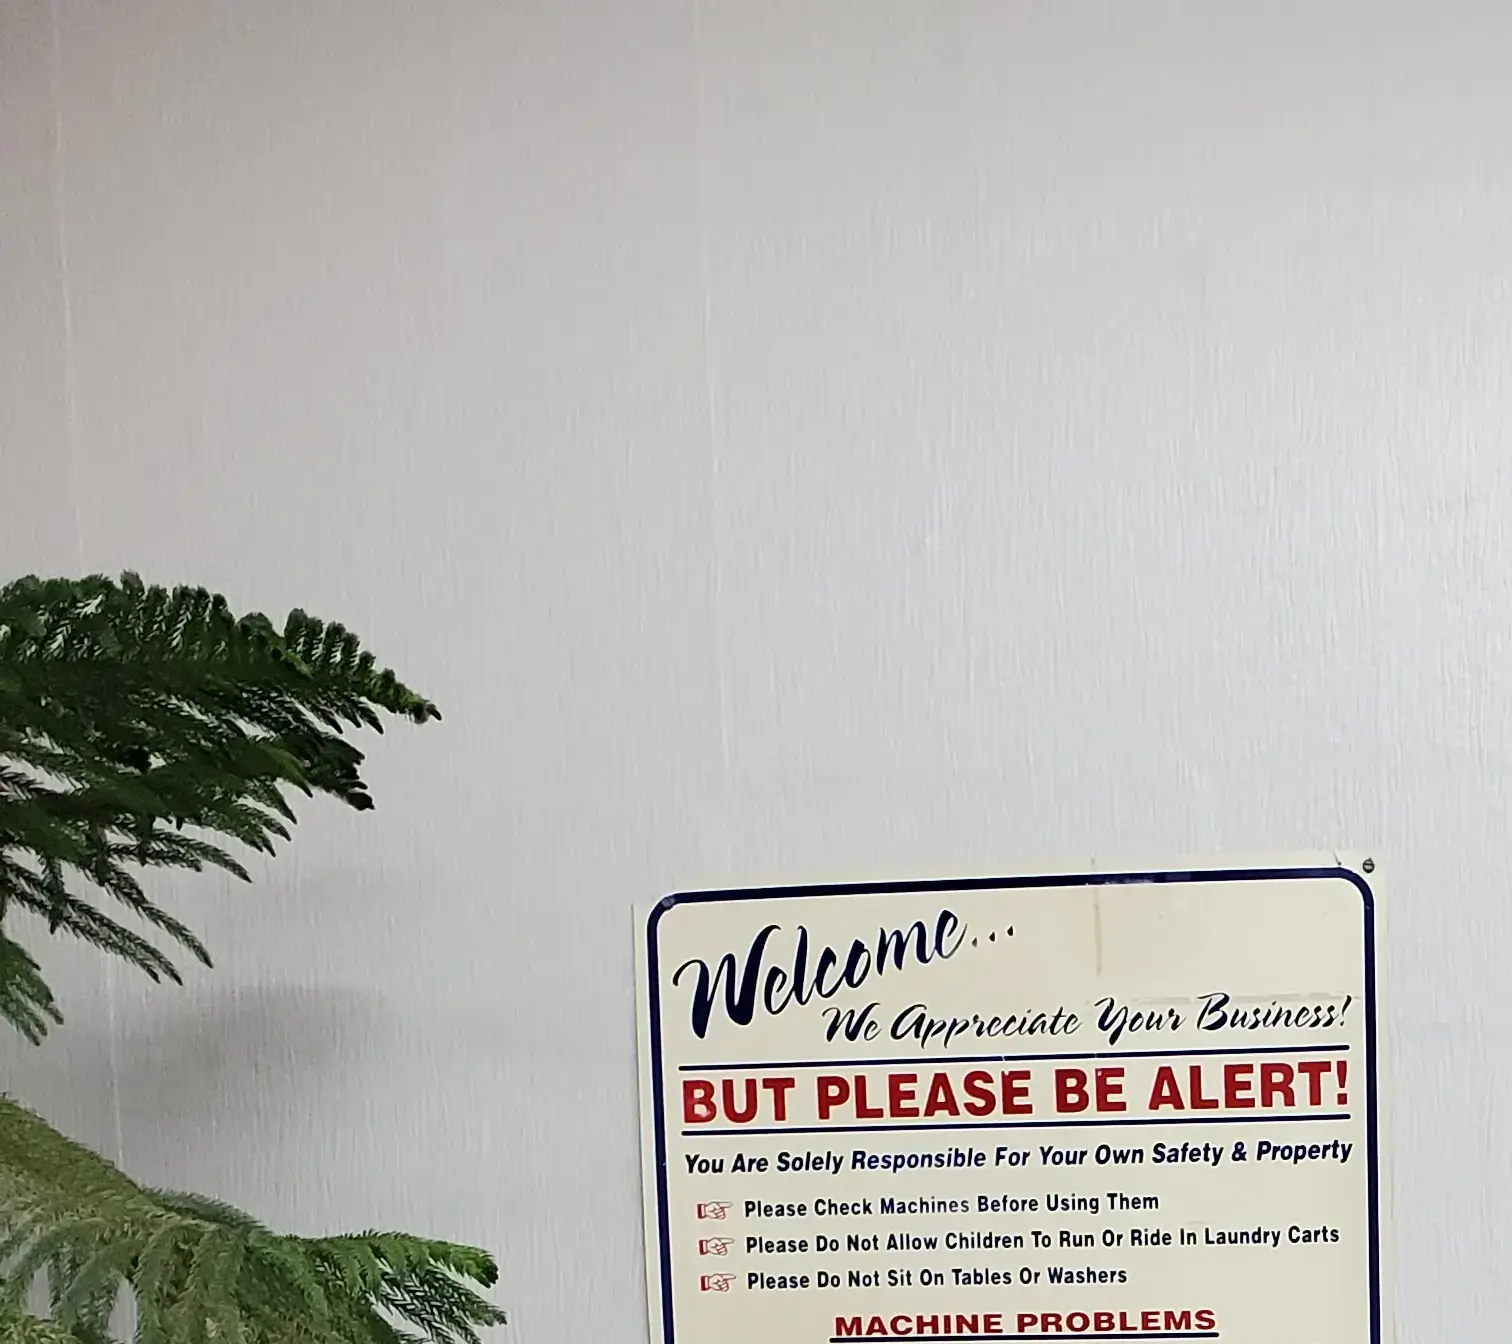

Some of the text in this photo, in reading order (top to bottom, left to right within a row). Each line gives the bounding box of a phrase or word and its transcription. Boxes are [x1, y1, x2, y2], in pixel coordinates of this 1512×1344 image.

[822, 993, 1351, 1049] We Appreciate Your Business!
[683, 1061, 1347, 1123] BUT PLEASE BE ALERT!
[685, 1140, 1352, 1174] You Are Solely Responsible For Your Own Safety & Property
[745, 1193, 1158, 1217] Please Check Machines Before Using Them
[747, 1226, 1339, 1254] Please Do Not Allow Children To Run Or Ride In Laundry Carts
[748, 1267, 1126, 1289] Please Do Not Sit On Tables Or Washers
[836, 1310, 1215, 1336] MACHINE PROBLEMS
